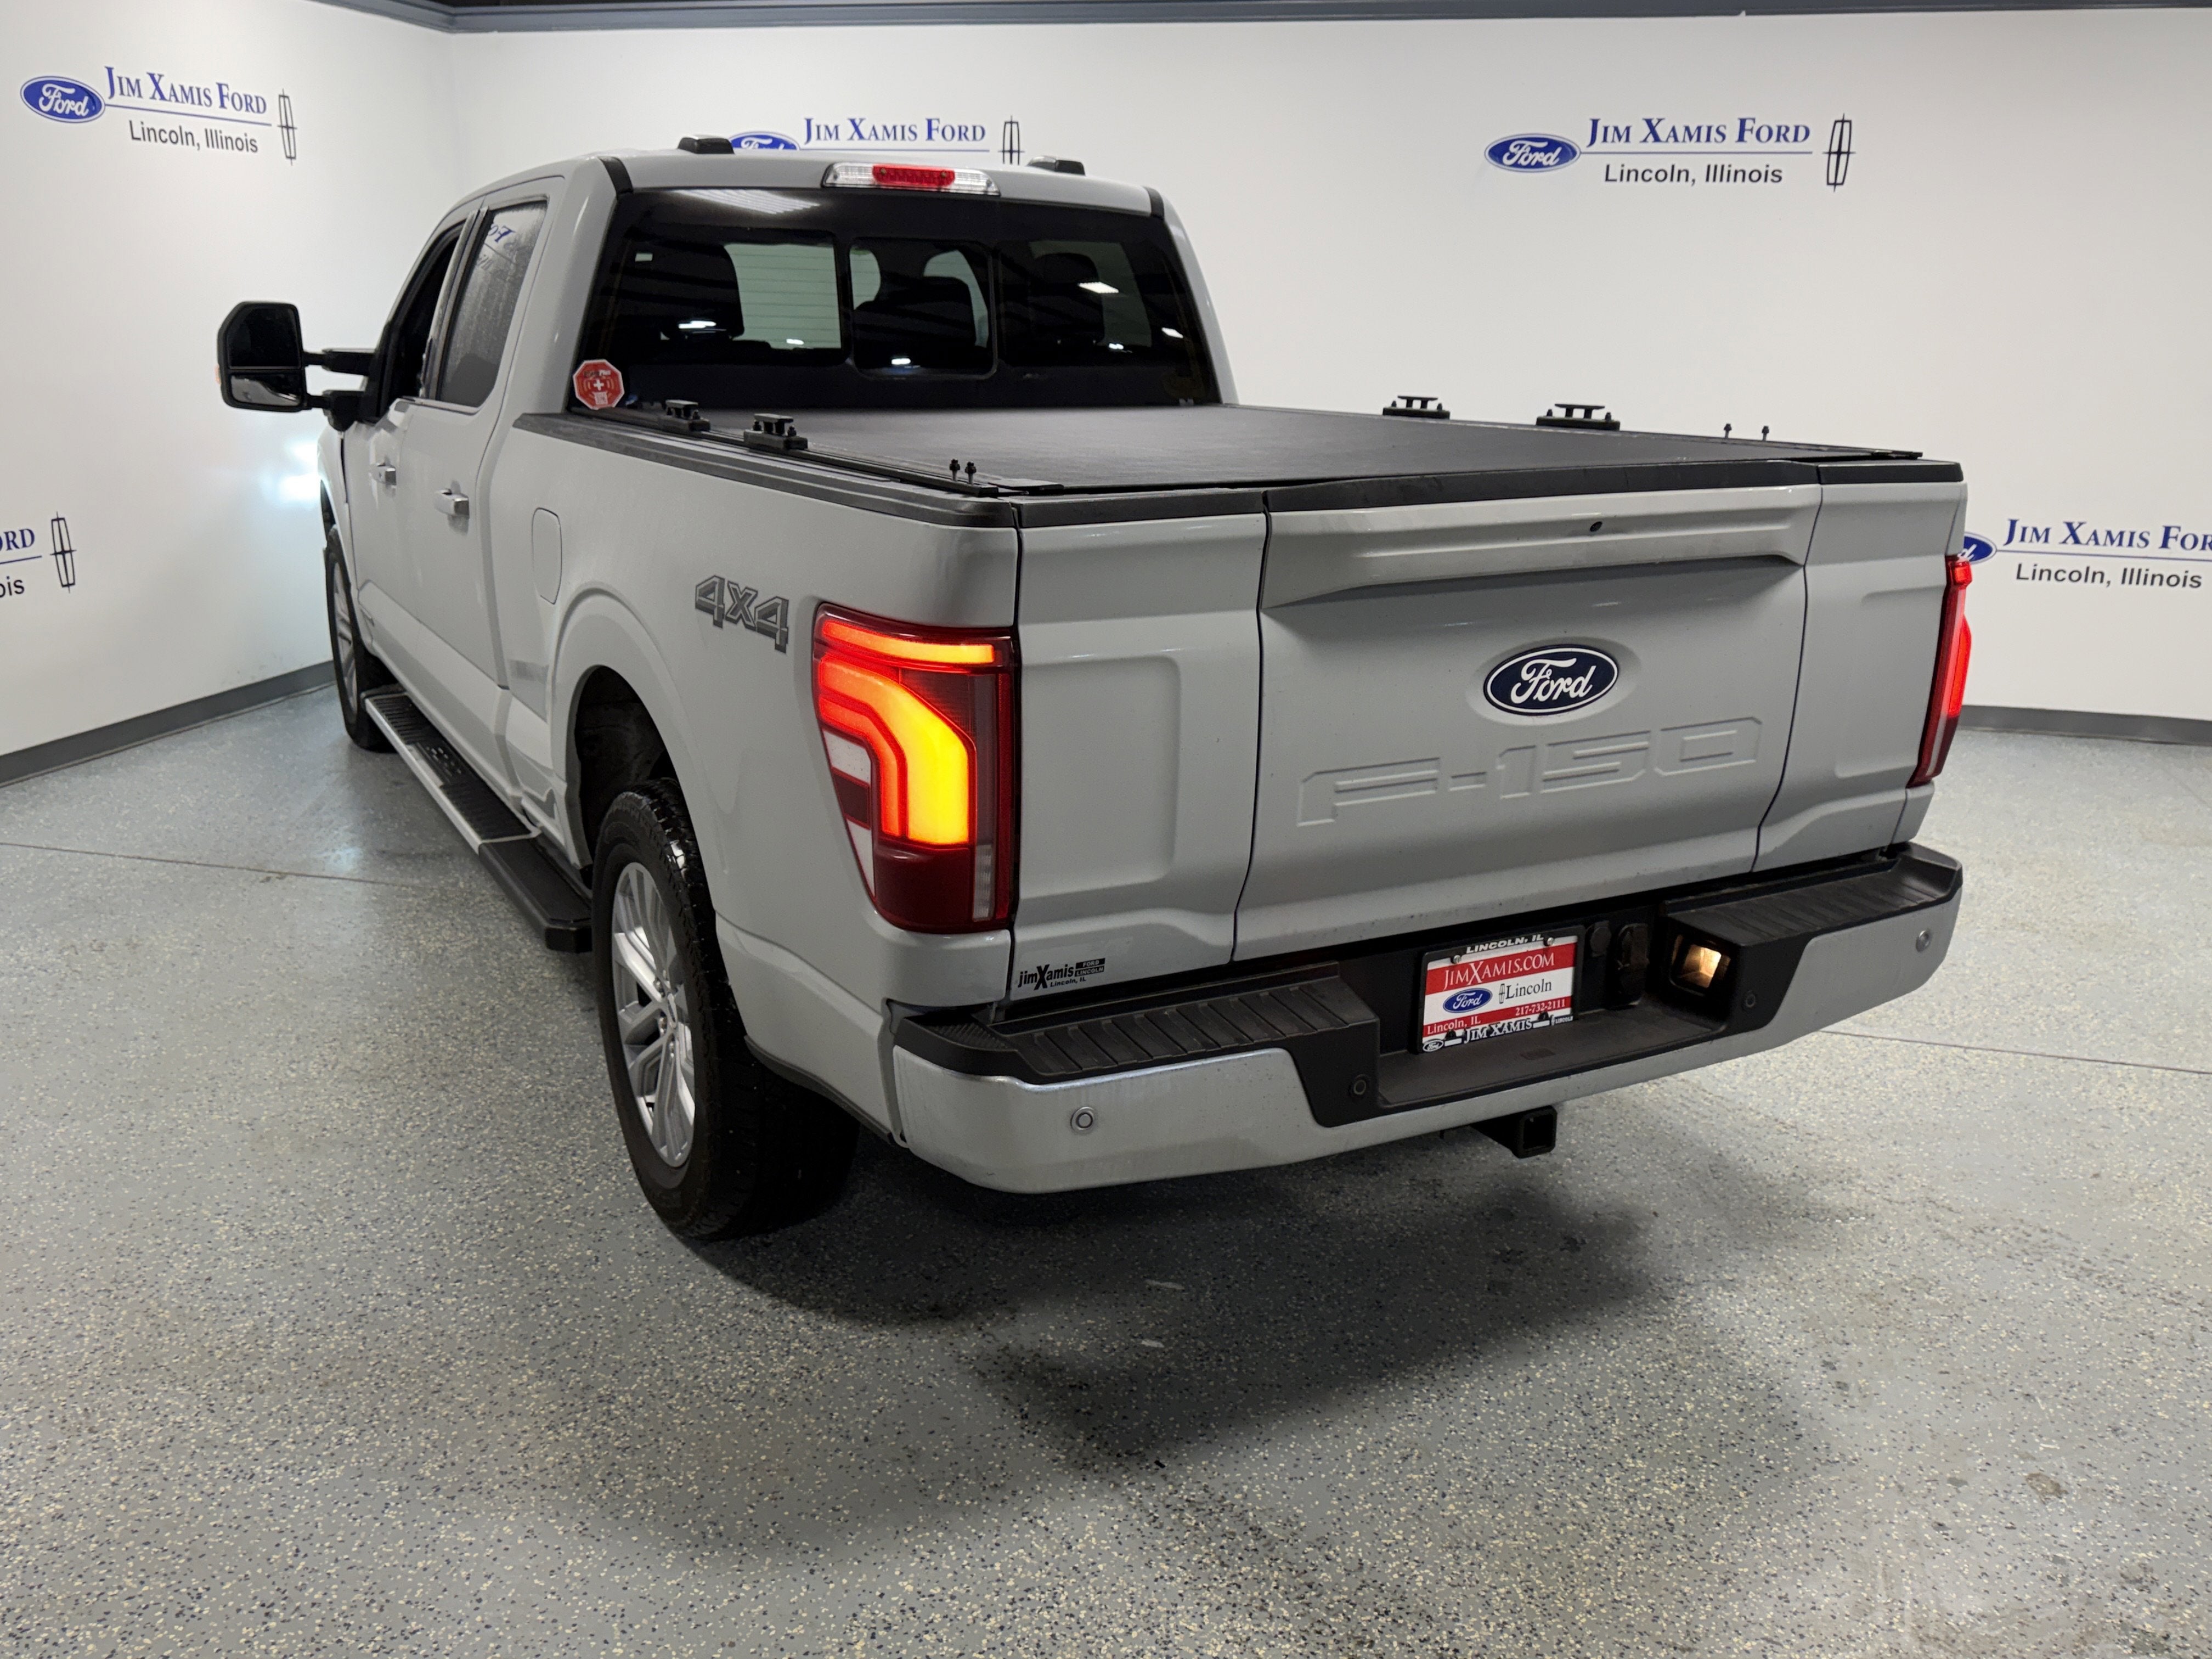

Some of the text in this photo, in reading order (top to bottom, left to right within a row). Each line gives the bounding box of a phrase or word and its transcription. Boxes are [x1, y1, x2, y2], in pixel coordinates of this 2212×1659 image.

[39, 82, 89, 117] Ford
[128, 120, 258, 153] Lincoln, Illinois
[1502, 139, 1563, 167] Ford
[1605, 164, 1783, 187] Lincoln, Illinois
[2016, 563, 2202, 589] Lincoln, Illinois
[1510, 657, 1597, 704] Ford
[1296, 716, 1763, 827] F-150
[1532, 934, 1544, 942] IL
[1076, 967, 1104, 976] LINCOLN
[1452, 991, 1483, 1009] Ford
[1505, 978, 1552, 1000] Lincoln
[1515, 998, 1565, 1016] 217-732-2111
[1427, 1015, 1482, 1036] Lincoln, IL
[1464, 1019, 1532, 1044] JIM XAMIS
